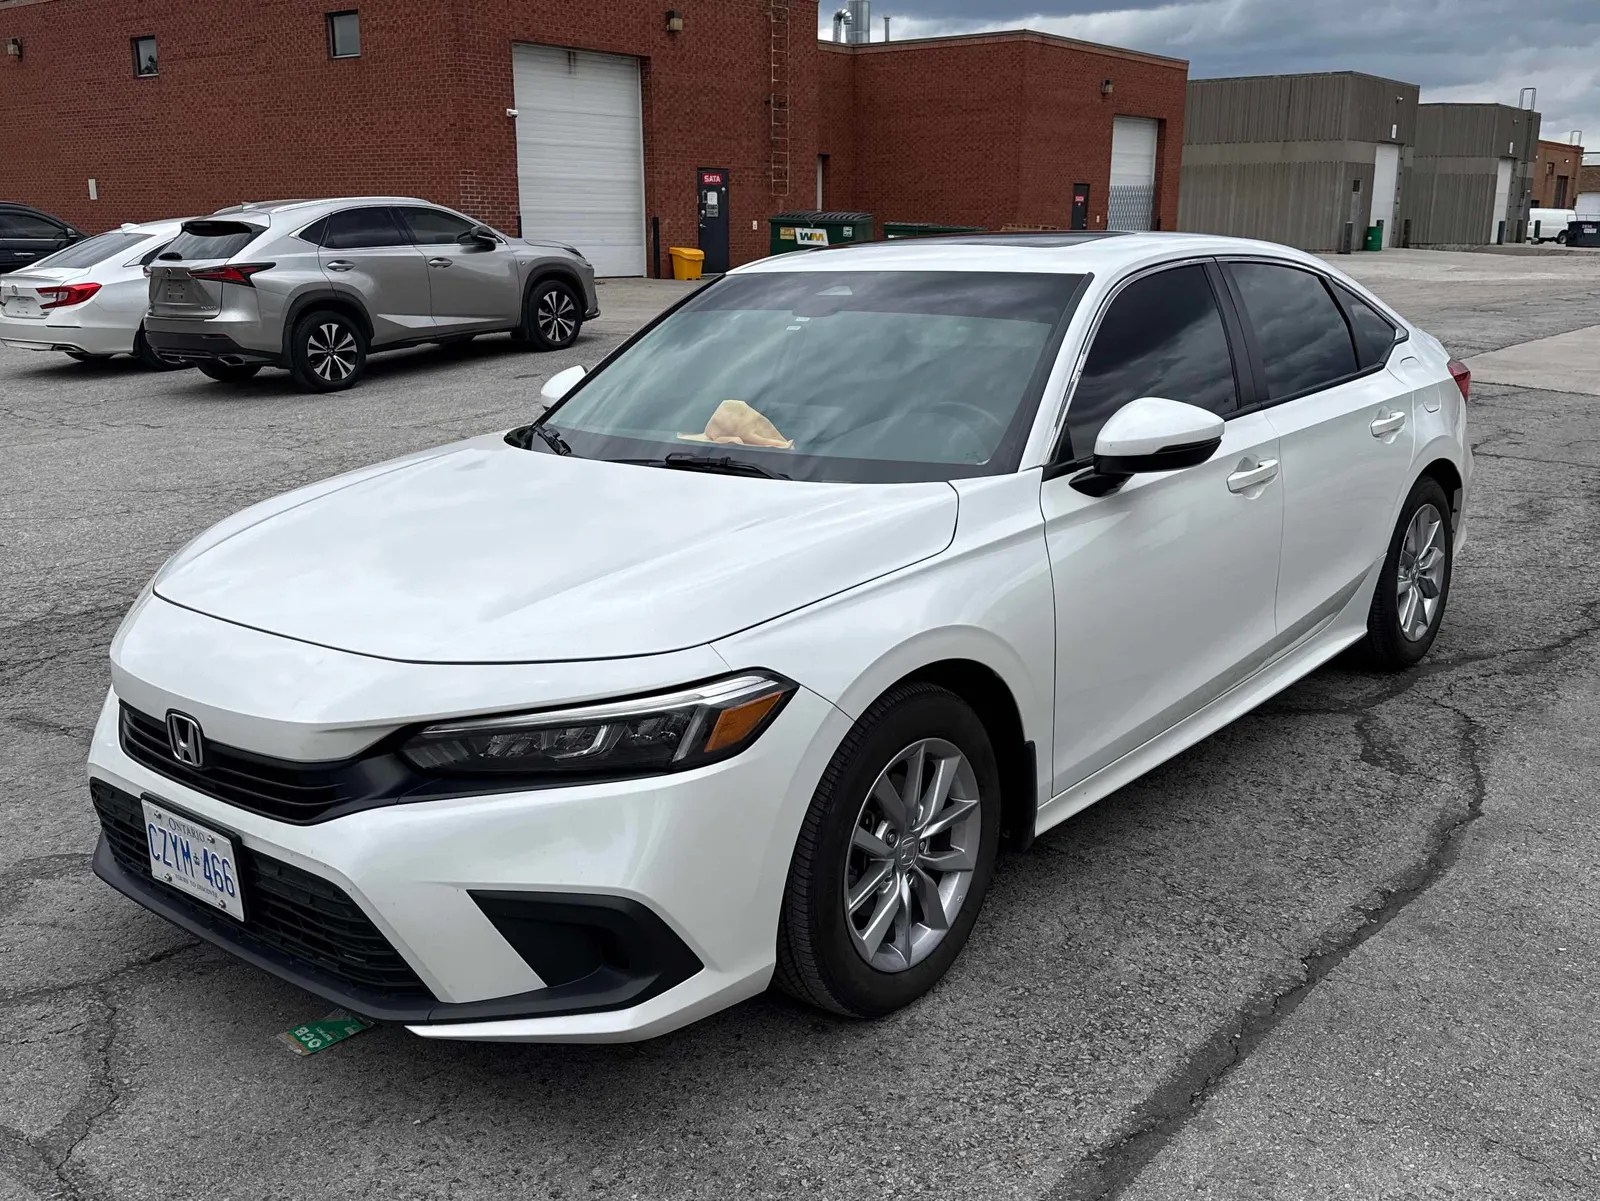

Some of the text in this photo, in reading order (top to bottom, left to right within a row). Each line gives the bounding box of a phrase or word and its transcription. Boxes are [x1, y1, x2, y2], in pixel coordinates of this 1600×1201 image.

[703, 175, 721, 183] SATA
[800, 232, 825, 242] WM
[148, 823, 236, 898] CZYM 466
[294, 1026, 322, 1048] OCB
